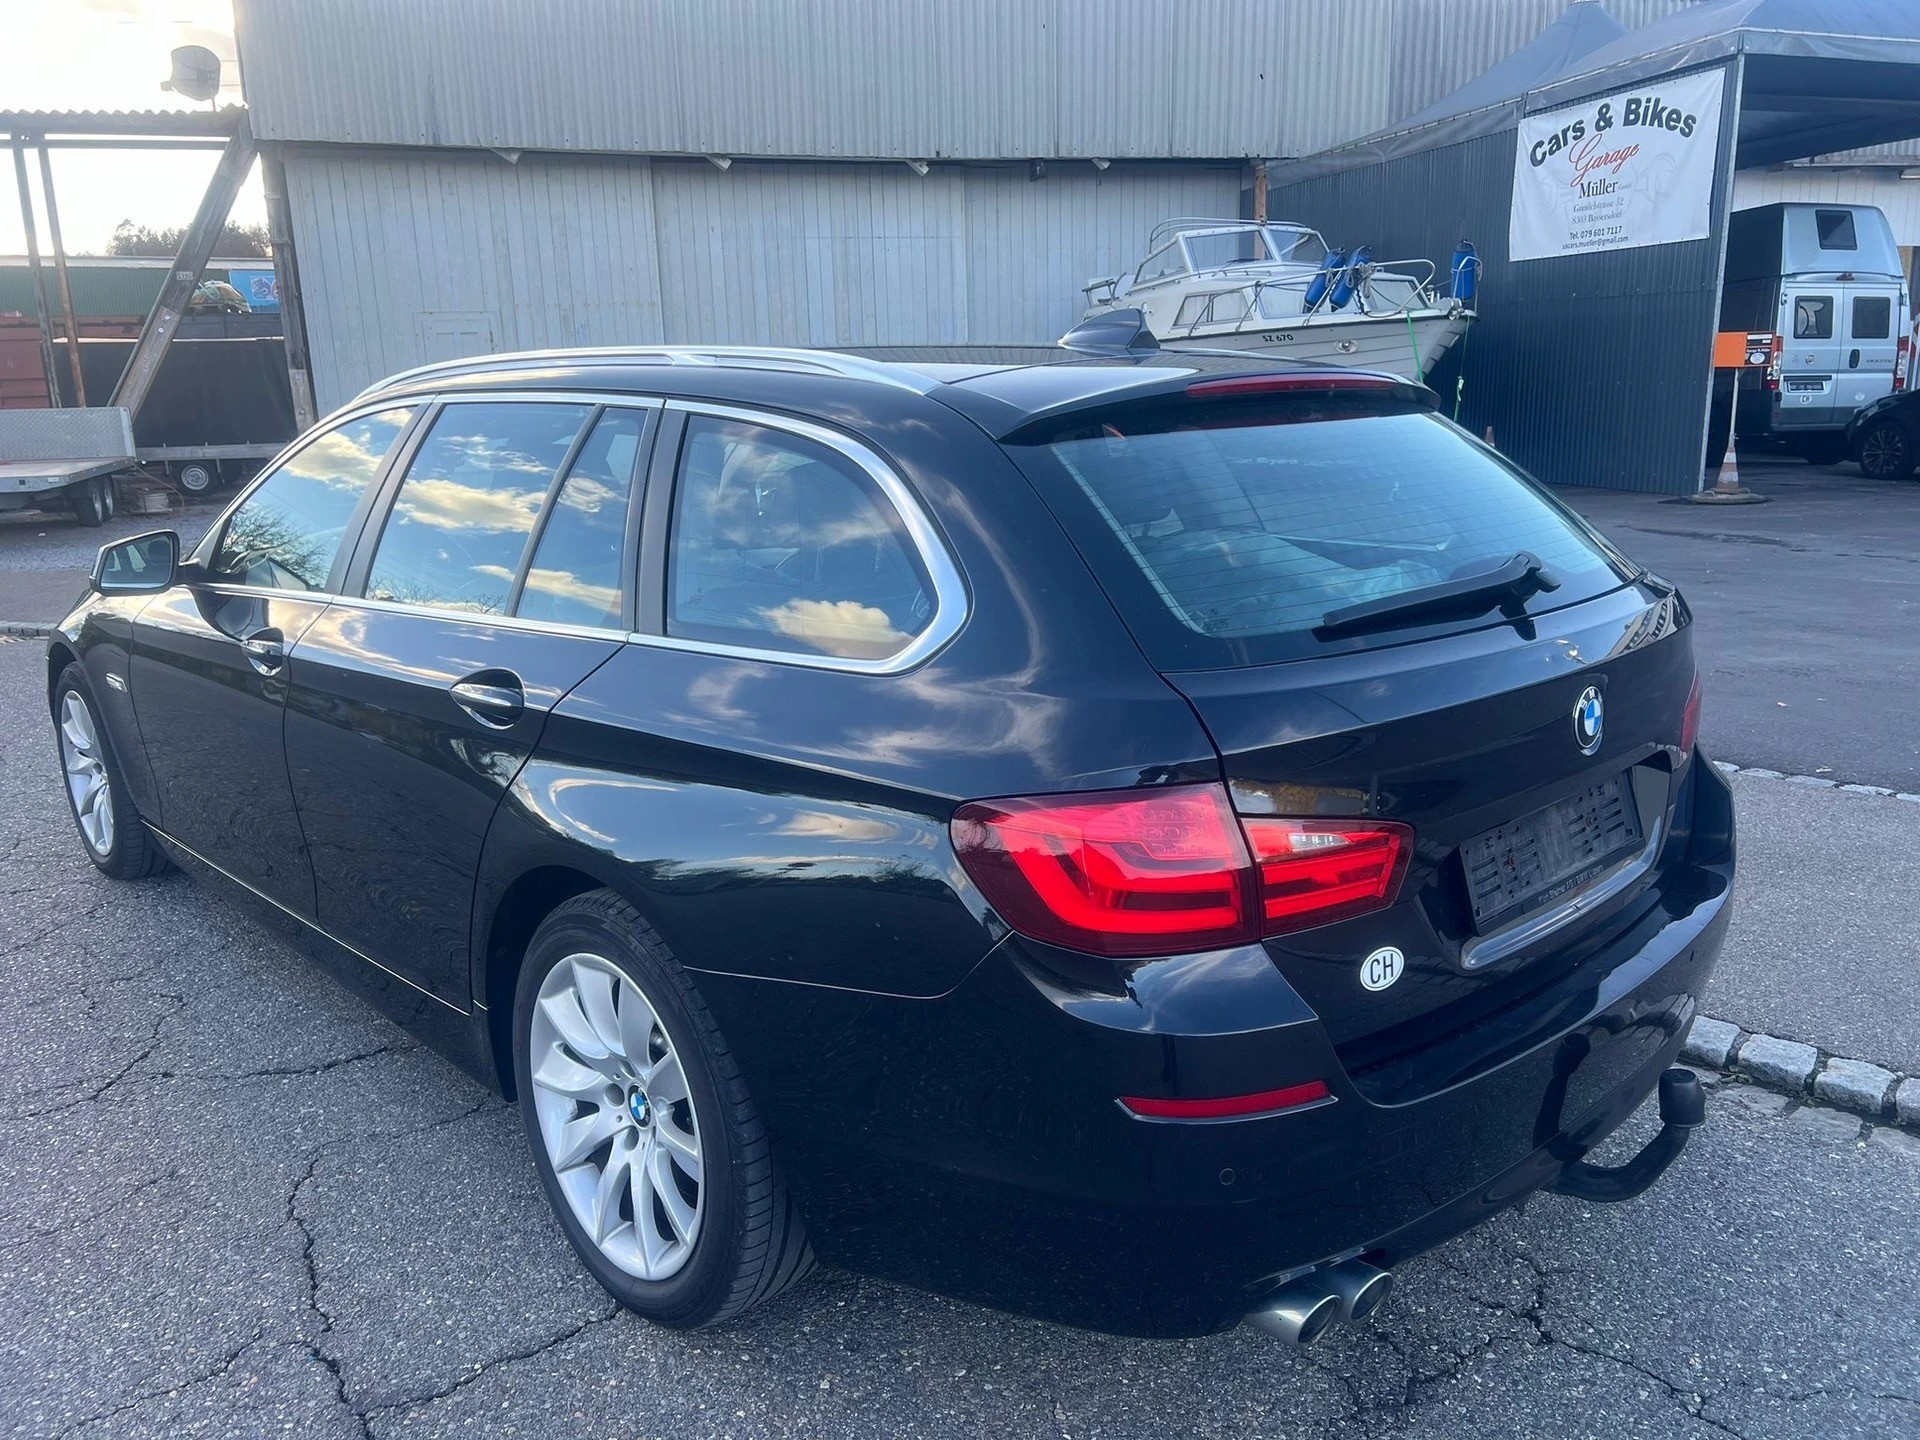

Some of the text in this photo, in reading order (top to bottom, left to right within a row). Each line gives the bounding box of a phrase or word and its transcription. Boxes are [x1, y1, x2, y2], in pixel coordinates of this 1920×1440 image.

[1530, 97, 1697, 168] Cars & Bikes
[1568, 132, 1640, 187] Garage
[1578, 178, 1619, 199] Müller
[1569, 226, 1622, 240] Tel. 079 601 7117
[1262, 333, 1294, 342] SZ 670
[1370, 953, 1394, 985] CH
